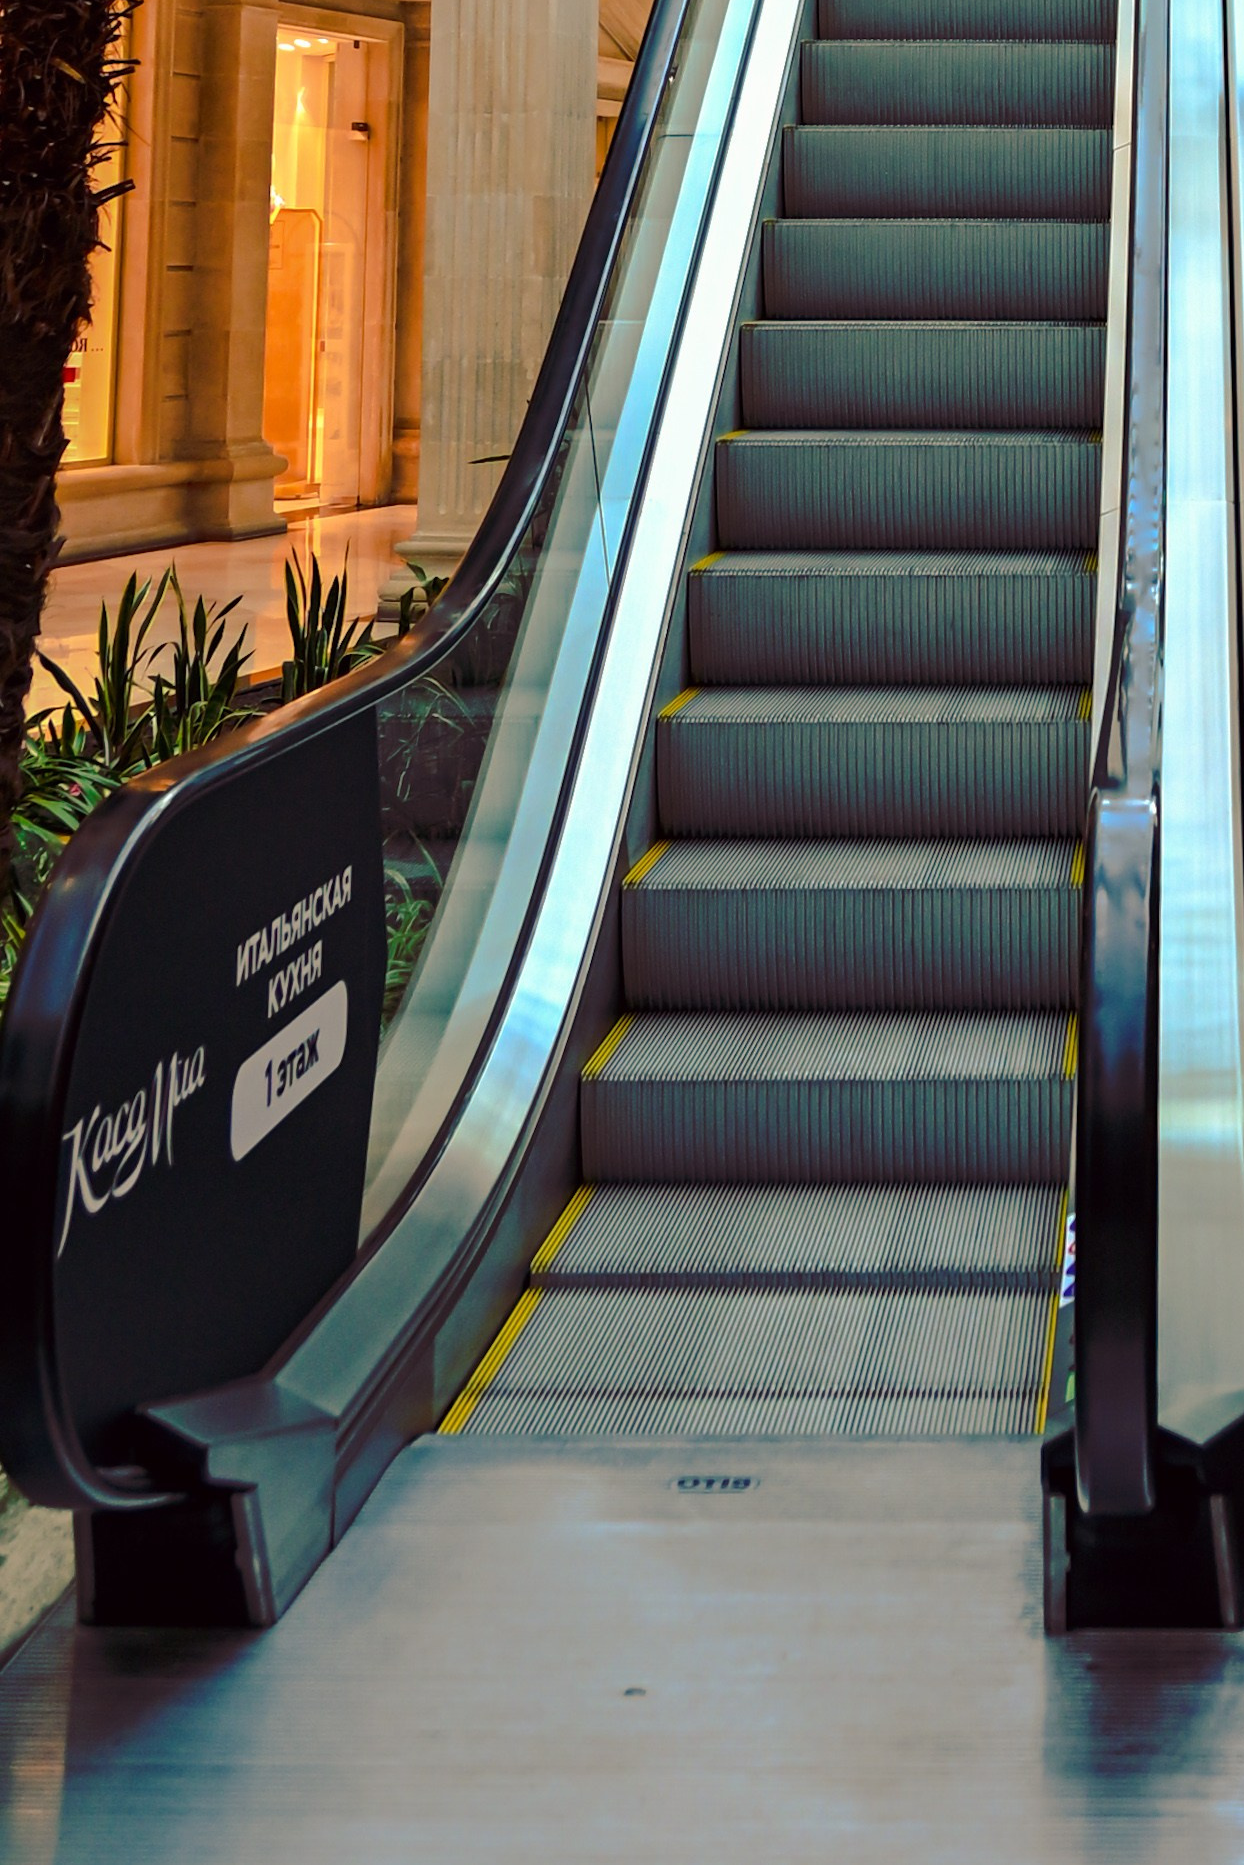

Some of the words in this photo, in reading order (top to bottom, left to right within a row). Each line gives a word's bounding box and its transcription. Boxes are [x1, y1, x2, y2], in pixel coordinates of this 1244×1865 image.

[236, 865, 352, 987] ИТАЛЬЯНСКАЯ
[267, 939, 323, 1019] КУХНЯ
[264, 1059, 273, 1108] 1
[276, 1028, 320, 1097] этаж
